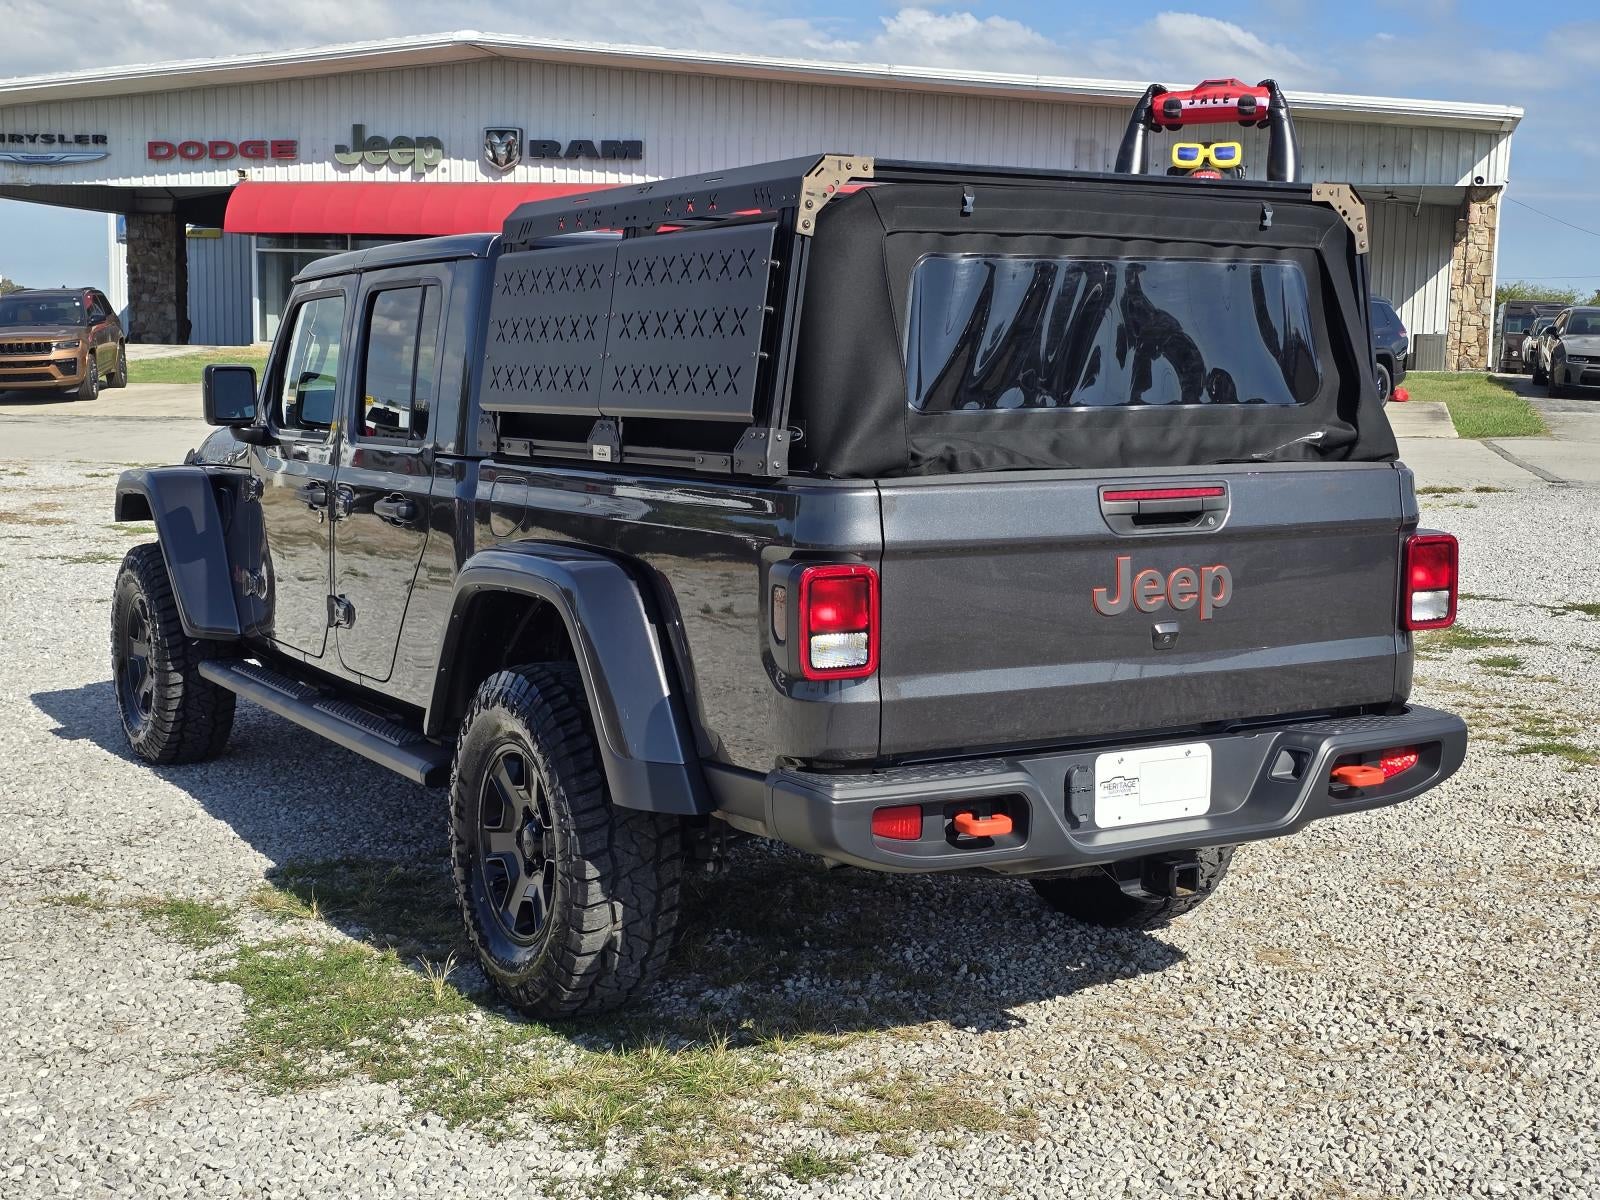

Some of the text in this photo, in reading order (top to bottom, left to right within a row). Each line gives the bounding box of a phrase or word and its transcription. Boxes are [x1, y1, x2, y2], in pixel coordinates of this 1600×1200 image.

[1188, 93, 1232, 106] SALE
[147, 139, 298, 161] DODGE
[334, 124, 444, 174] Jeep
[529, 139, 643, 161] RAM
[1092, 555, 1233, 621] Jeep
[1103, 780, 1136, 791] HERITAGE
